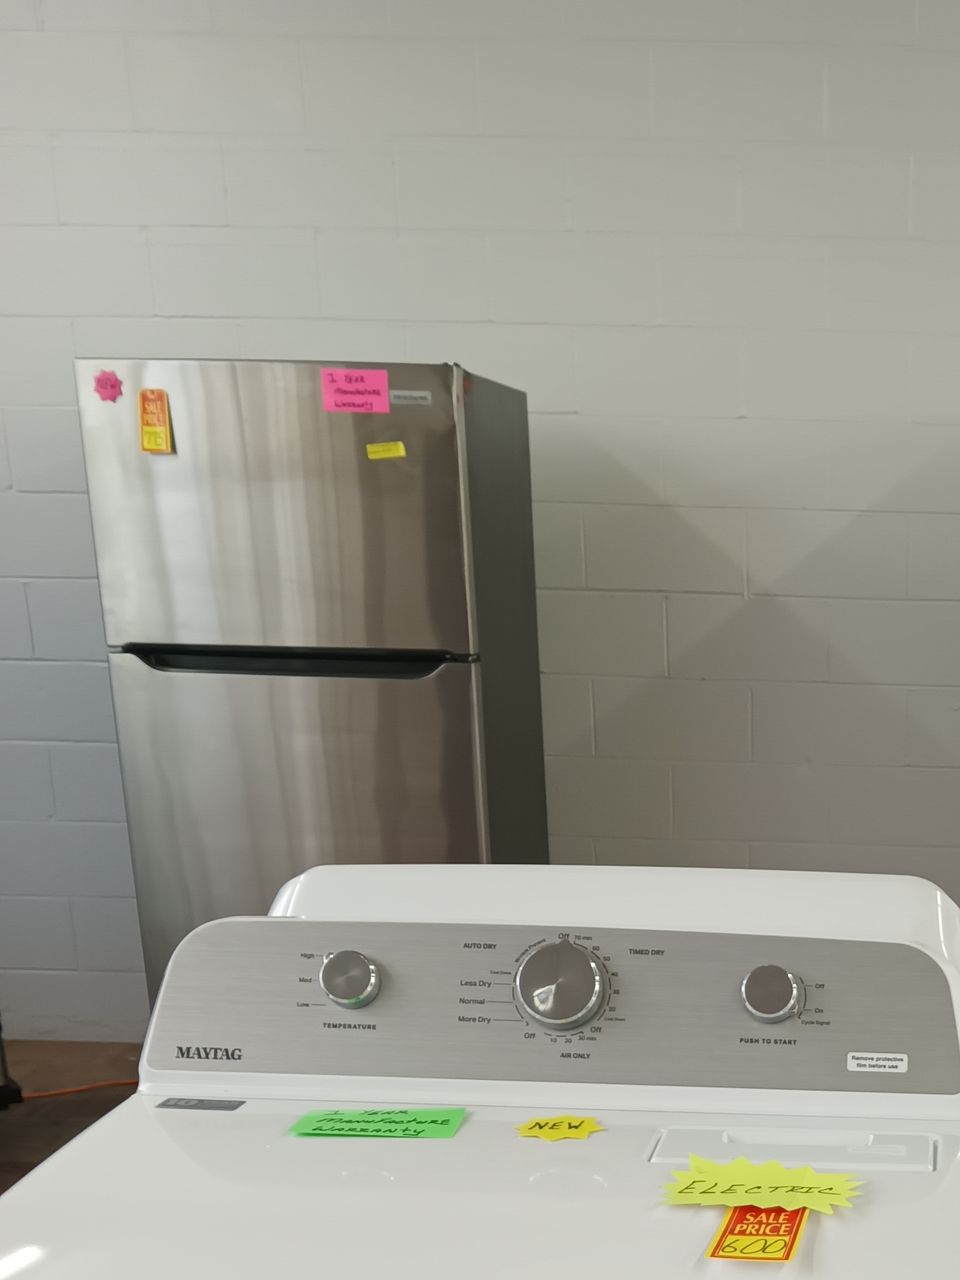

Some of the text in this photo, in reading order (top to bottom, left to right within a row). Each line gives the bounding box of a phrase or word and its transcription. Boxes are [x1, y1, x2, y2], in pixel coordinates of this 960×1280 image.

[475, 981, 492, 989] Dry
[323, 1022, 377, 1031] TEMPERATURE
[475, 1017, 492, 1025] Dry
[175, 1046, 243, 1062] MAYTAG
[875, 1056, 904, 1064] protective
[528, 1120, 585, 1130] NEW
[677, 1180, 842, 1196] ELECTRIC
[743, 1211, 791, 1224] SALE
[733, 1223, 792, 1235] PRICE
[720, 1238, 788, 1255] 600
